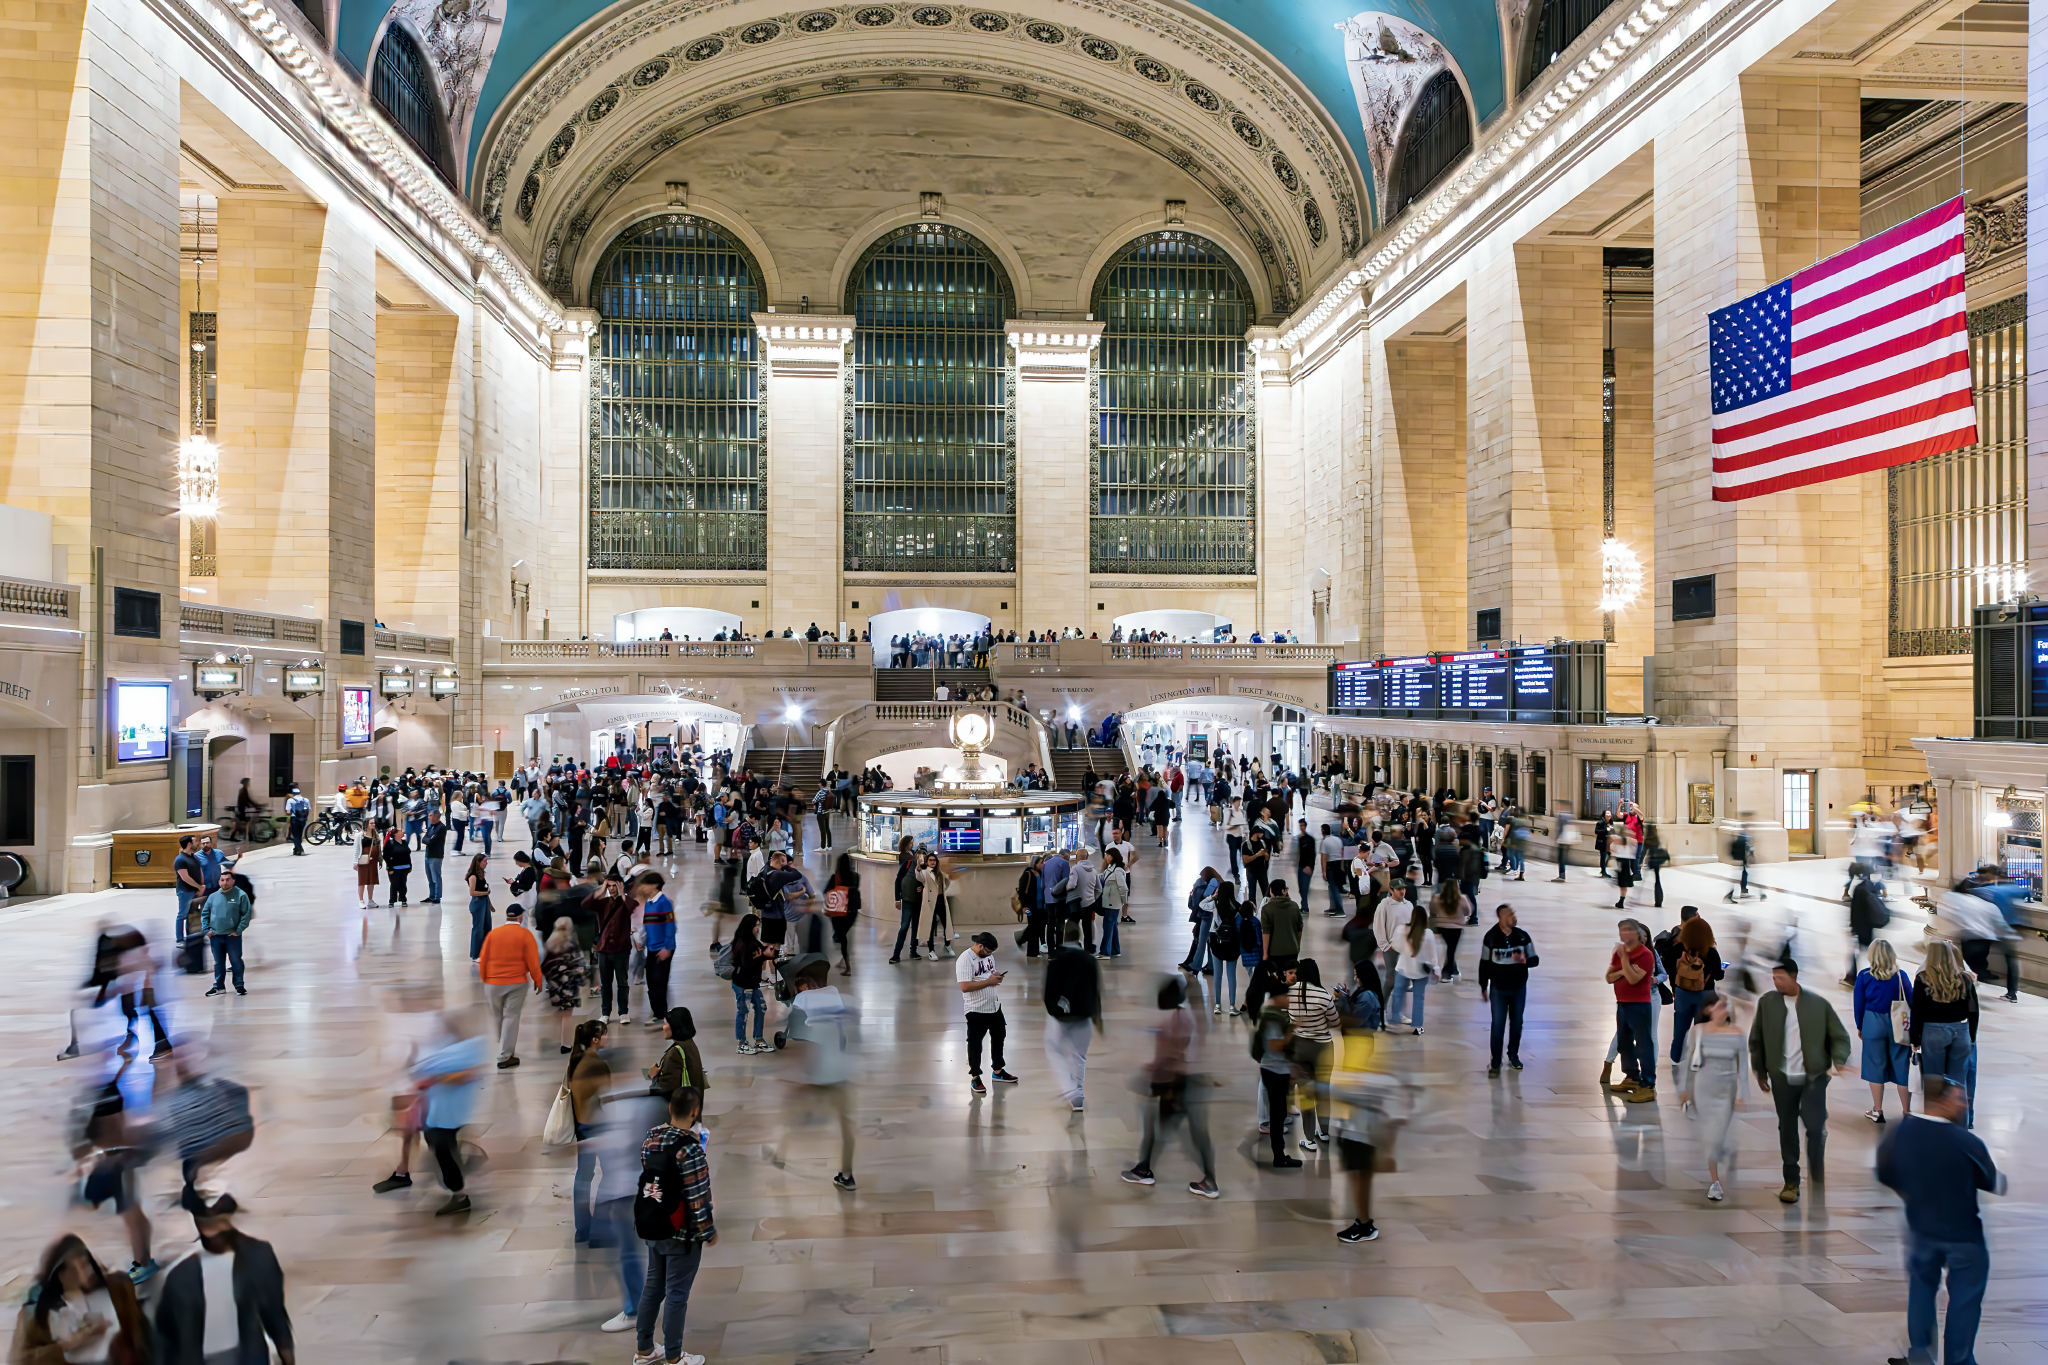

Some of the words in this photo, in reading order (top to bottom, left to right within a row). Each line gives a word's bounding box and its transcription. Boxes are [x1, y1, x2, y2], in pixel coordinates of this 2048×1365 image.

[558, 689, 589, 700] TRACKS
[600, 686, 611, 694] TO
[648, 686, 696, 698] LEXINTON
[1150, 687, 1195, 702] LEXINGTON
[1197, 686, 1212, 694] AVE
[1238, 686, 1263, 694] TICKET
[1266, 690, 1304, 703] MACHINES
[606, 716, 624, 724] 42ND
